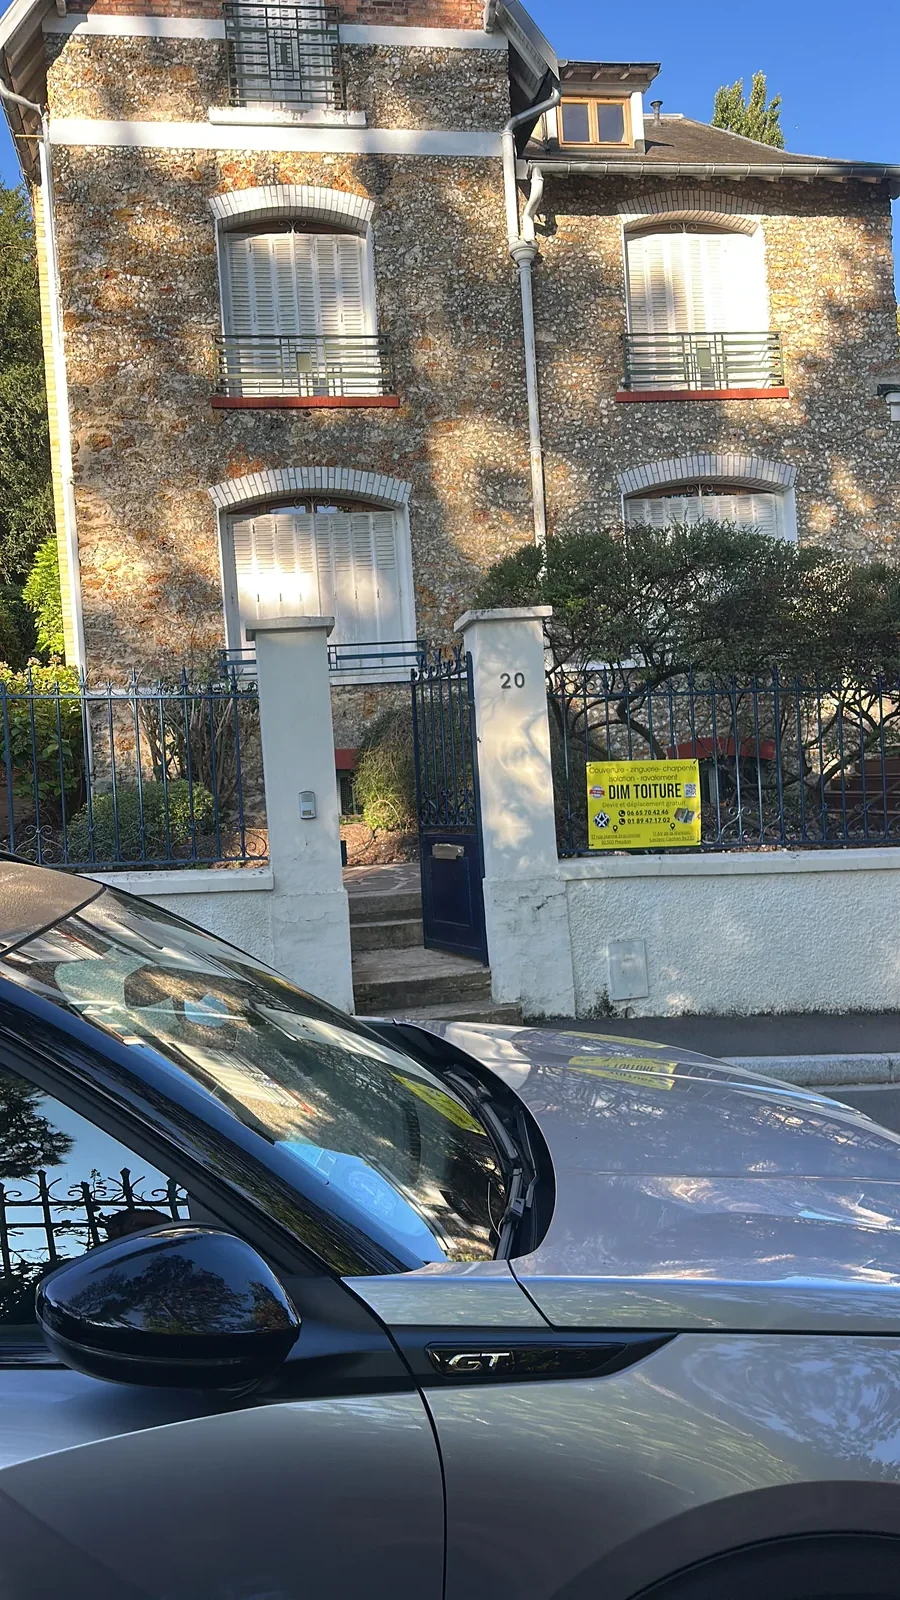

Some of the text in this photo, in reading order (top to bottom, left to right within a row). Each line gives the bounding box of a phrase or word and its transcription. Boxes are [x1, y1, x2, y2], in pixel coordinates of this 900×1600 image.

[500, 672, 525, 689] 20
[589, 766, 624, 774] Couverture
[662, 765, 697, 773] charpente
[608, 783, 682, 800] DIM TOITURE
[666, 800, 686, 808] gratuit
[449, 1353, 510, 1371] GT
